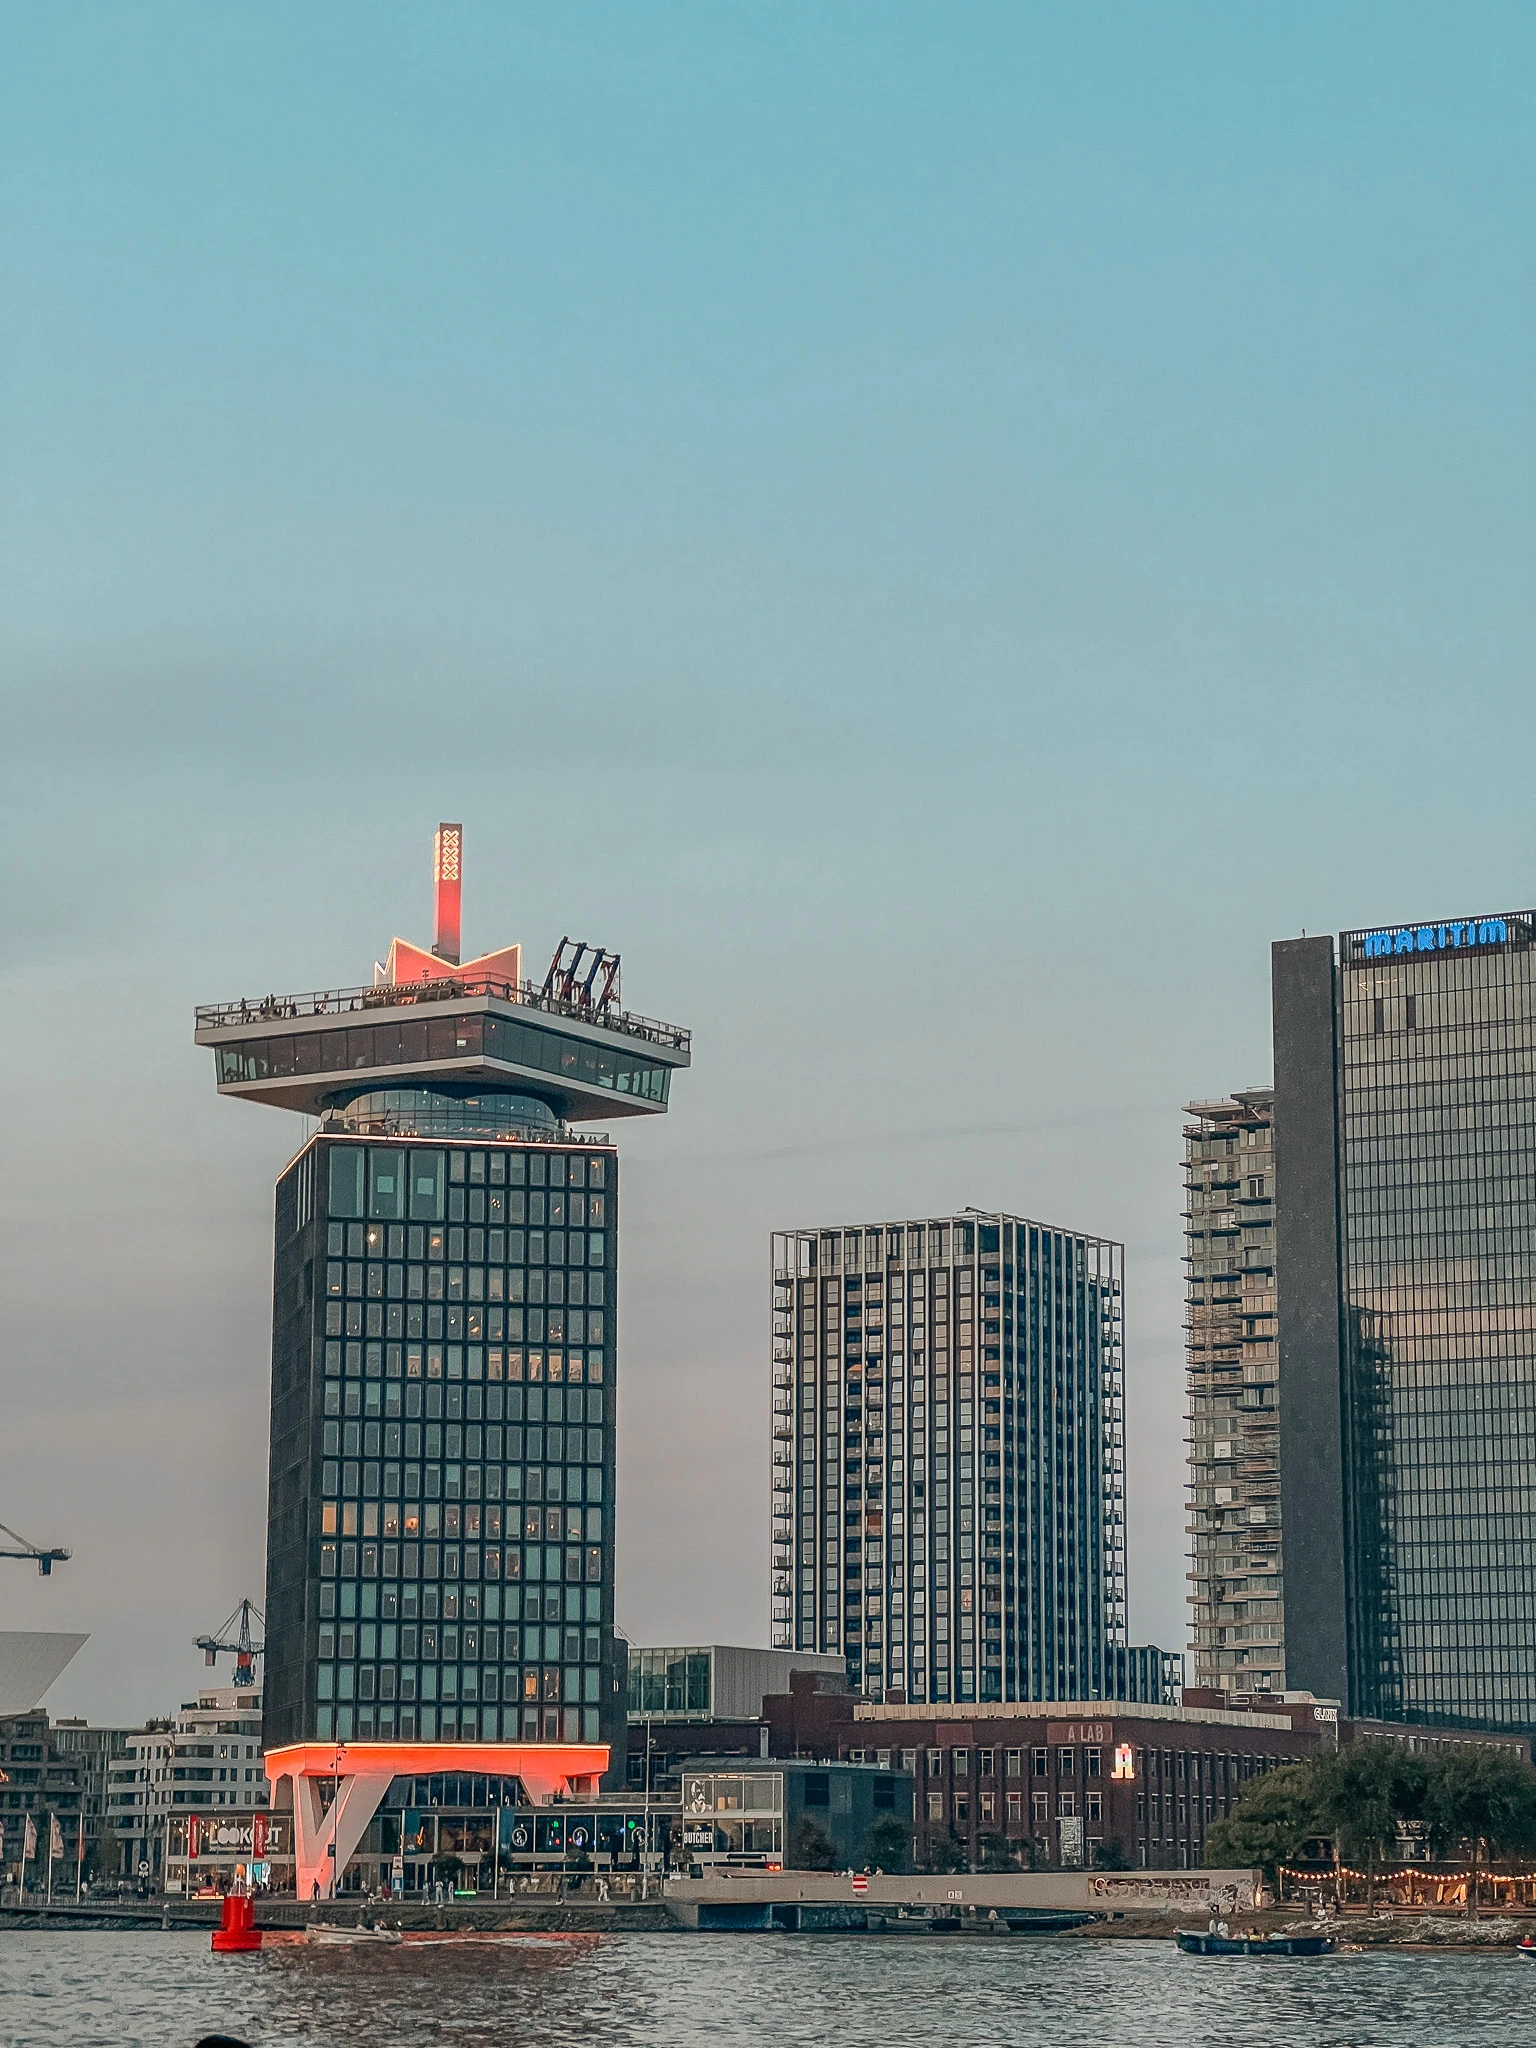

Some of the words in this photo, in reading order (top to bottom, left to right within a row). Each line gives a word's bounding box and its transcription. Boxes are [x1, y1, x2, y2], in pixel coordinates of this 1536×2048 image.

[1364, 919, 1507, 959] MARITIM
[1068, 1725, 1076, 1742] A
[1080, 1724, 1104, 1742] LAB
[683, 1832, 714, 1844] BUTCHER
